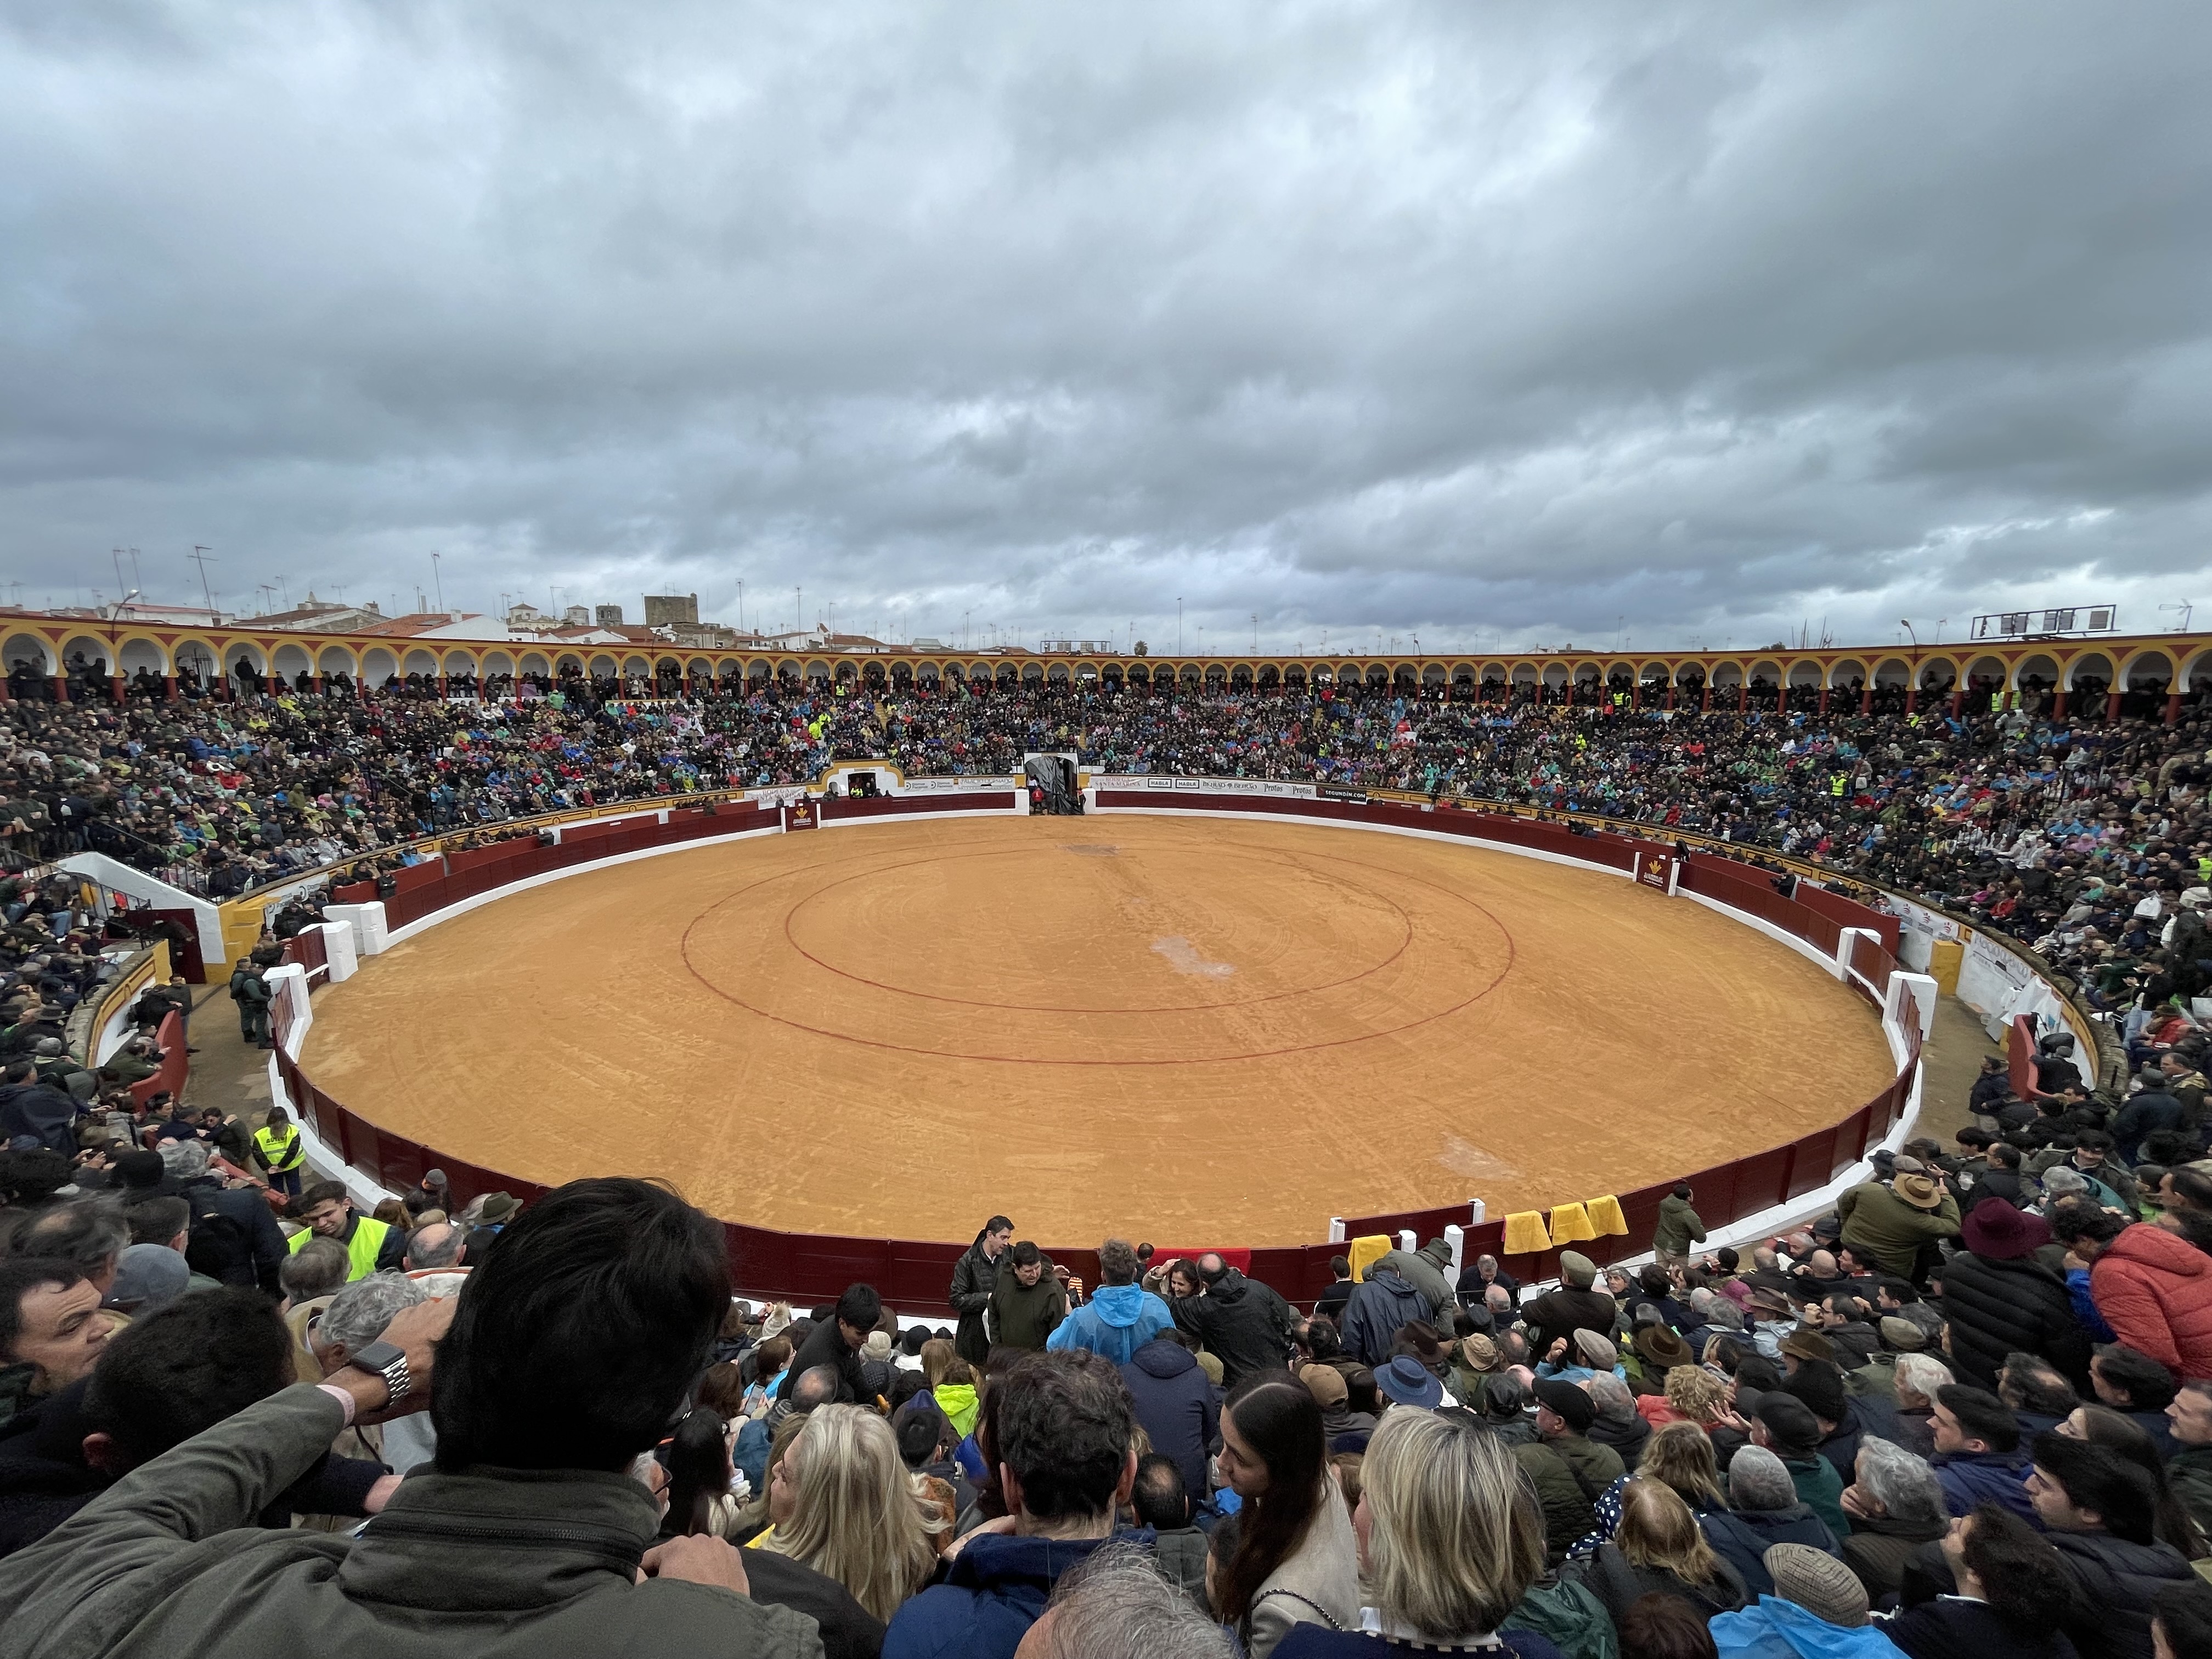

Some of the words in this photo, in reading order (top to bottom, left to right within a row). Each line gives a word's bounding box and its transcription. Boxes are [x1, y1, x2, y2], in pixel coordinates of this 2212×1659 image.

[1263, 783, 1283, 792] Protos
[1291, 785, 1312, 795] Protos
[1325, 790, 1366, 798] SEGUNDÍN.COM
